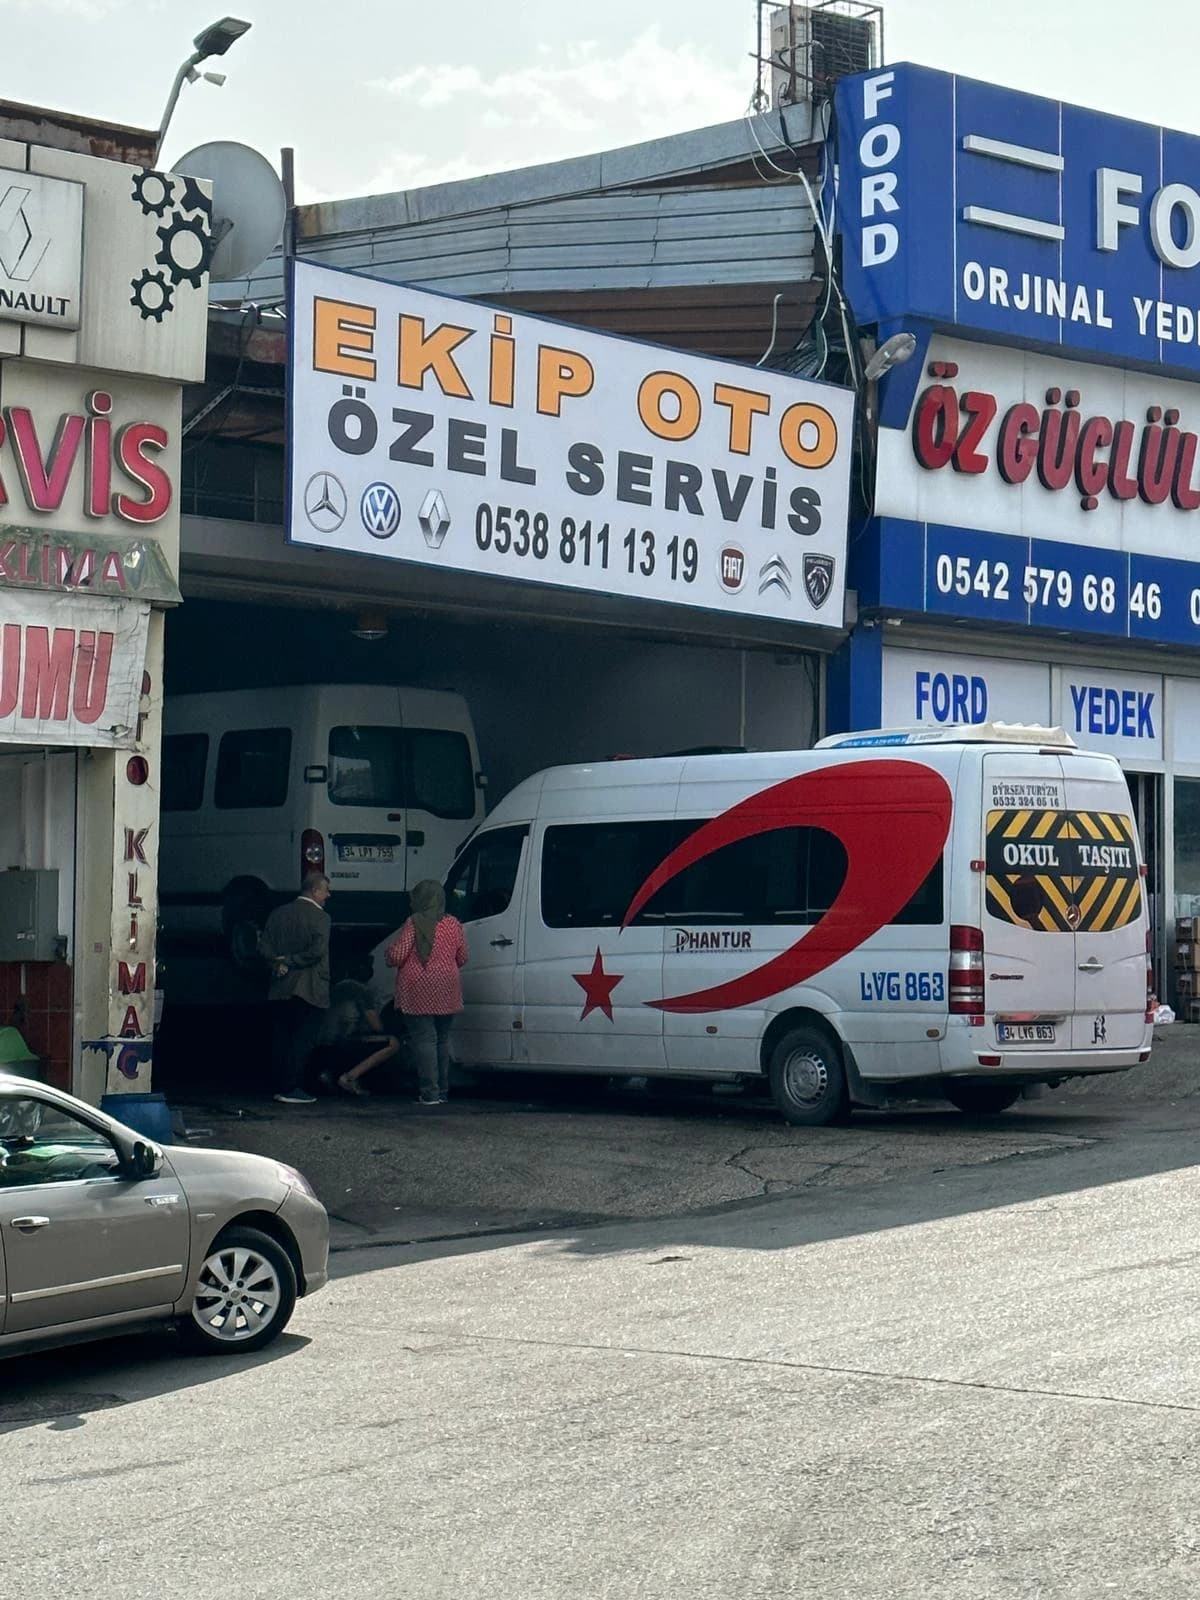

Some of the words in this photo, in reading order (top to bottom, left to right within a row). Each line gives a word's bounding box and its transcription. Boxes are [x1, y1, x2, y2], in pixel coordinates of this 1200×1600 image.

[859, 71, 901, 267] FORD
[1096, 167, 1200, 269] FO
[963, 261, 1113, 329] ORJINAL
[1132, 296, 1200, 347] YED
[313, 296, 595, 417] EKİP
[637, 370, 838, 469] OTO
[0, 390, 173, 524] VİS
[328, 385, 537, 486] ÖZEL
[565, 442, 822, 536] SERVİS
[475, 502, 549, 560] 0538
[559, 516, 610, 570] 811
[623, 527, 655, 577] 13
[666, 535, 698, 583] 19
[723, 555, 743, 581] FIAT
[937, 555, 1010, 600] 0542
[1023, 566, 1072, 608] 579
[1083, 574, 1116, 614] 68
[1130, 582, 1161, 620] 46
[916, 671, 988, 725] FORD
[1070, 685, 1155, 739] YEDEK
[1003, 843, 1059, 867] OKUL
[1078, 845, 1131, 874] TAŞITI
[860, 972, 900, 1001] LVG
[905, 972, 944, 1001] 863
[1004, 1026, 1015, 1040] 34
[1018, 1026, 1034, 1039] LVG
[1036, 1026, 1053, 1039] 863
